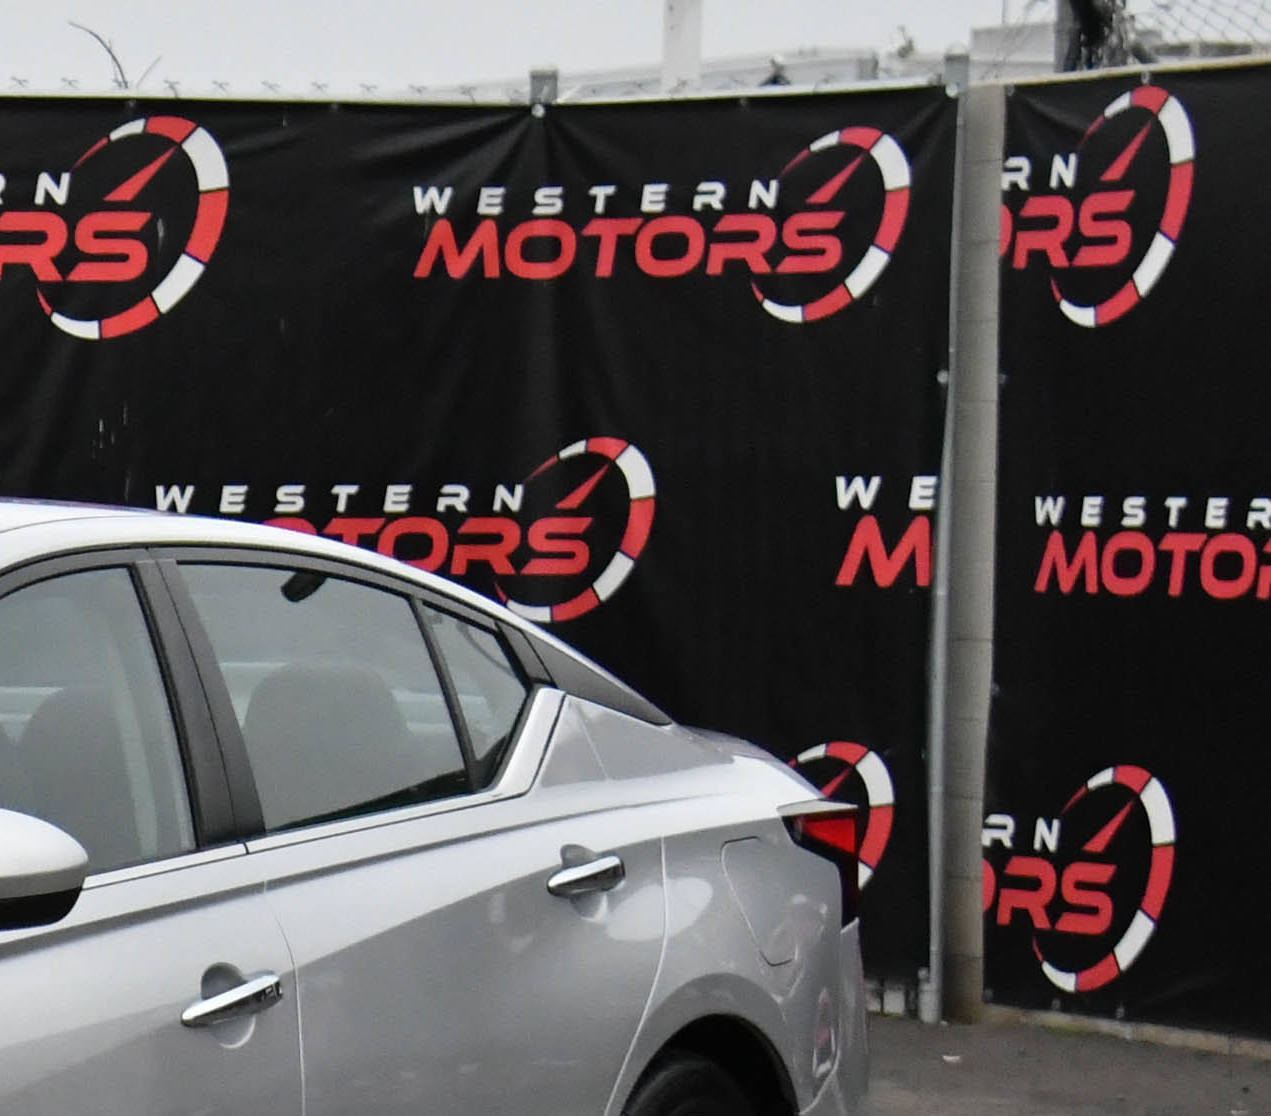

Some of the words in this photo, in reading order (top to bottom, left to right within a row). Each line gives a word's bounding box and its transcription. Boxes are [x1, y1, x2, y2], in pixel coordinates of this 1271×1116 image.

[413, 179, 778, 215] WESTERN
[999, 188, 1136, 270] RS
[413, 210, 845, 280] MOTORS
[154, 484, 524, 514] WESTERN
[263, 516, 593, 575] TORS
[1034, 530, 1271, 599] MOTO
[982, 855, 1116, 935] RS
